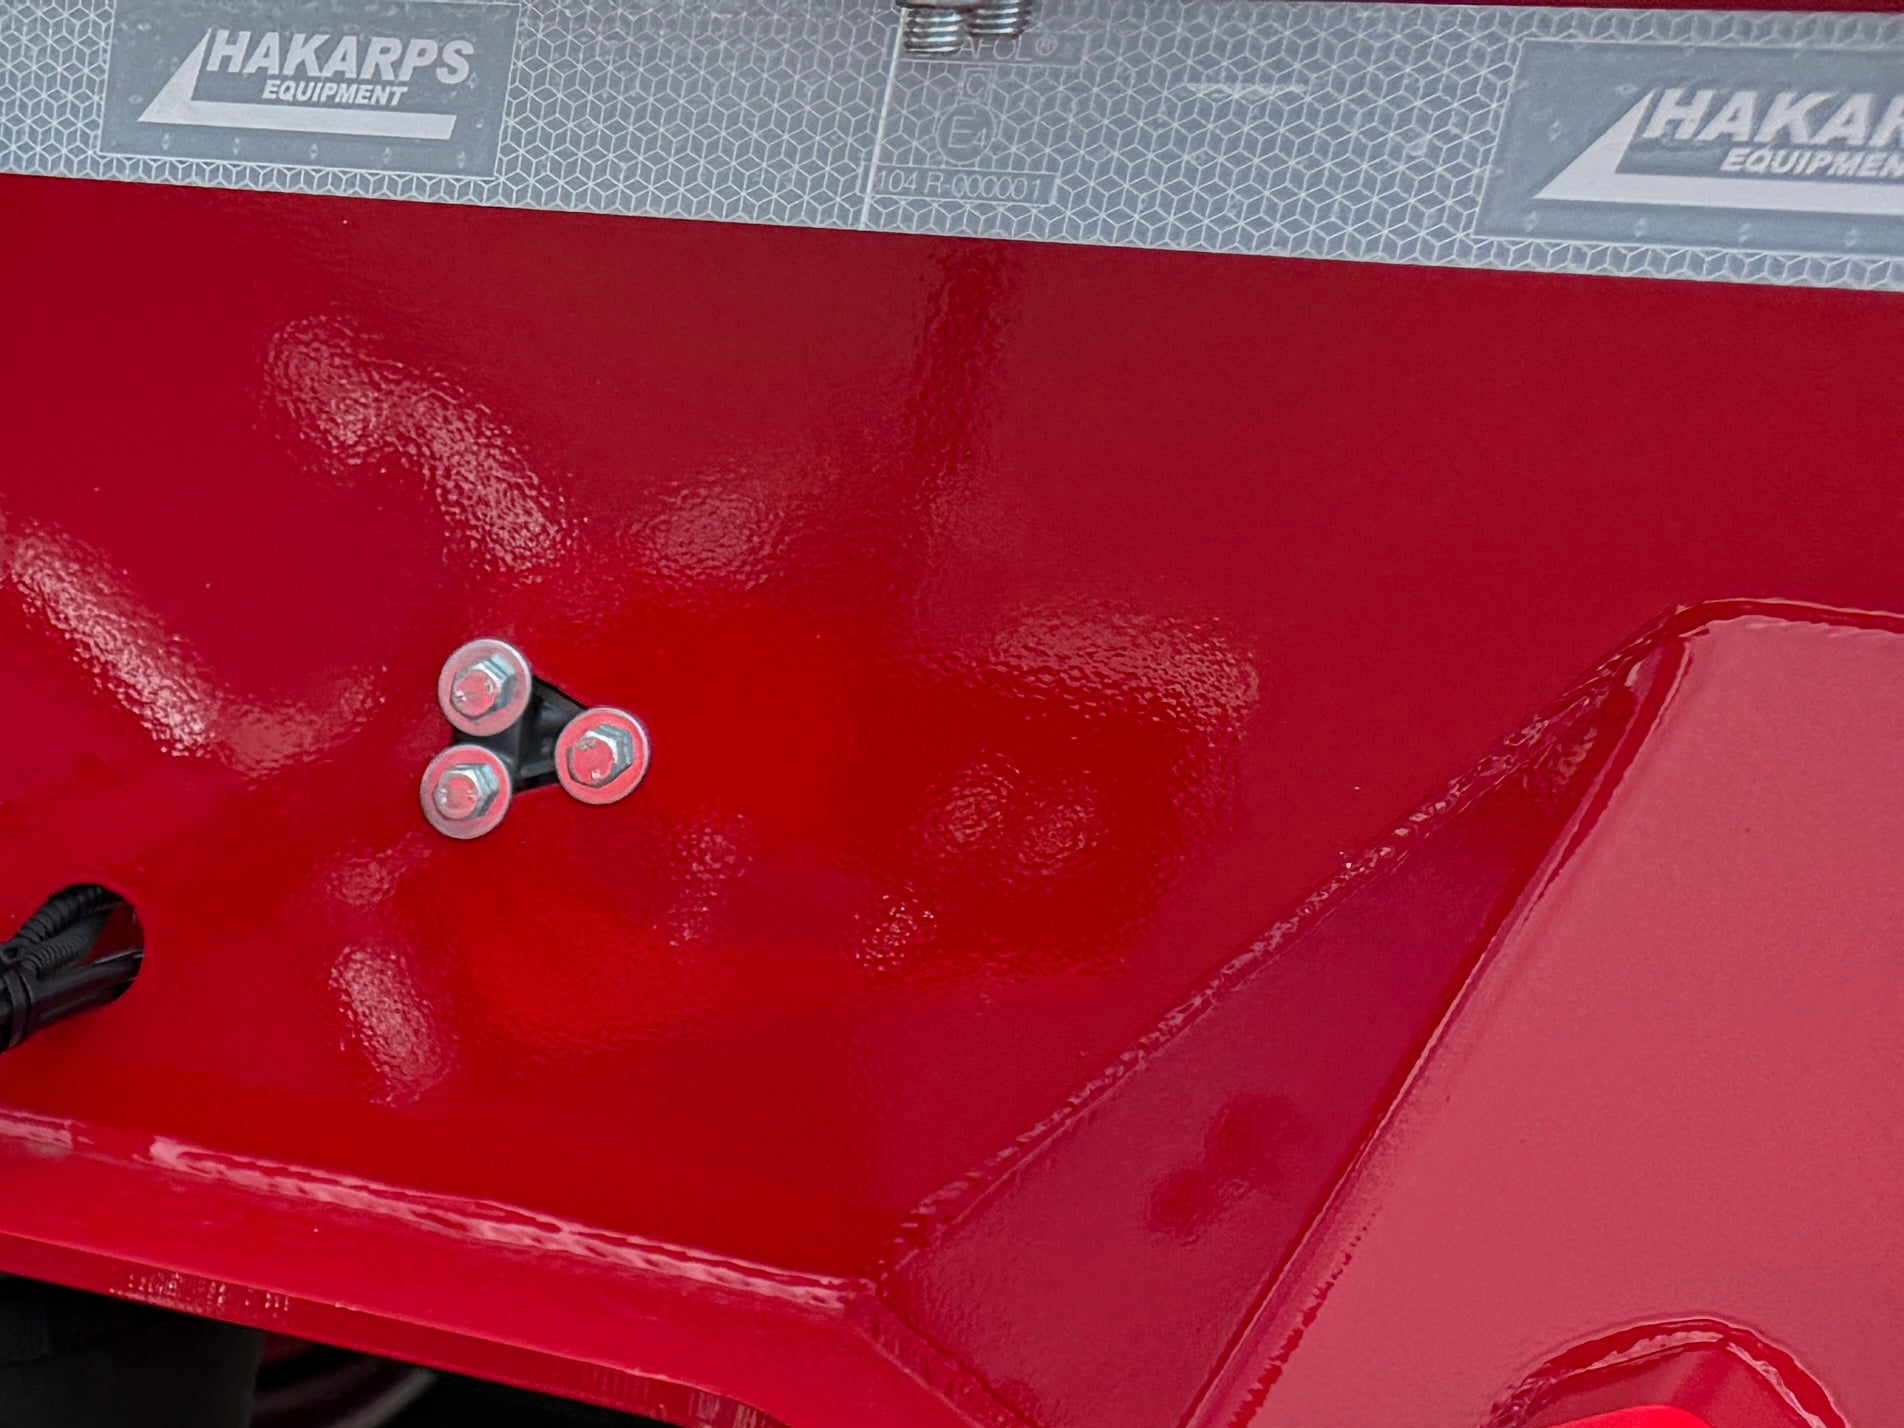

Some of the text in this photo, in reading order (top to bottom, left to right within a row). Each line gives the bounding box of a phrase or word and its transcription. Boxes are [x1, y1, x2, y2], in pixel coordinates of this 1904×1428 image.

[206, 29, 475, 85] HAKARPS
[261, 79, 409, 107] EQUIPMENT
[878, 169, 917, 193] 104
